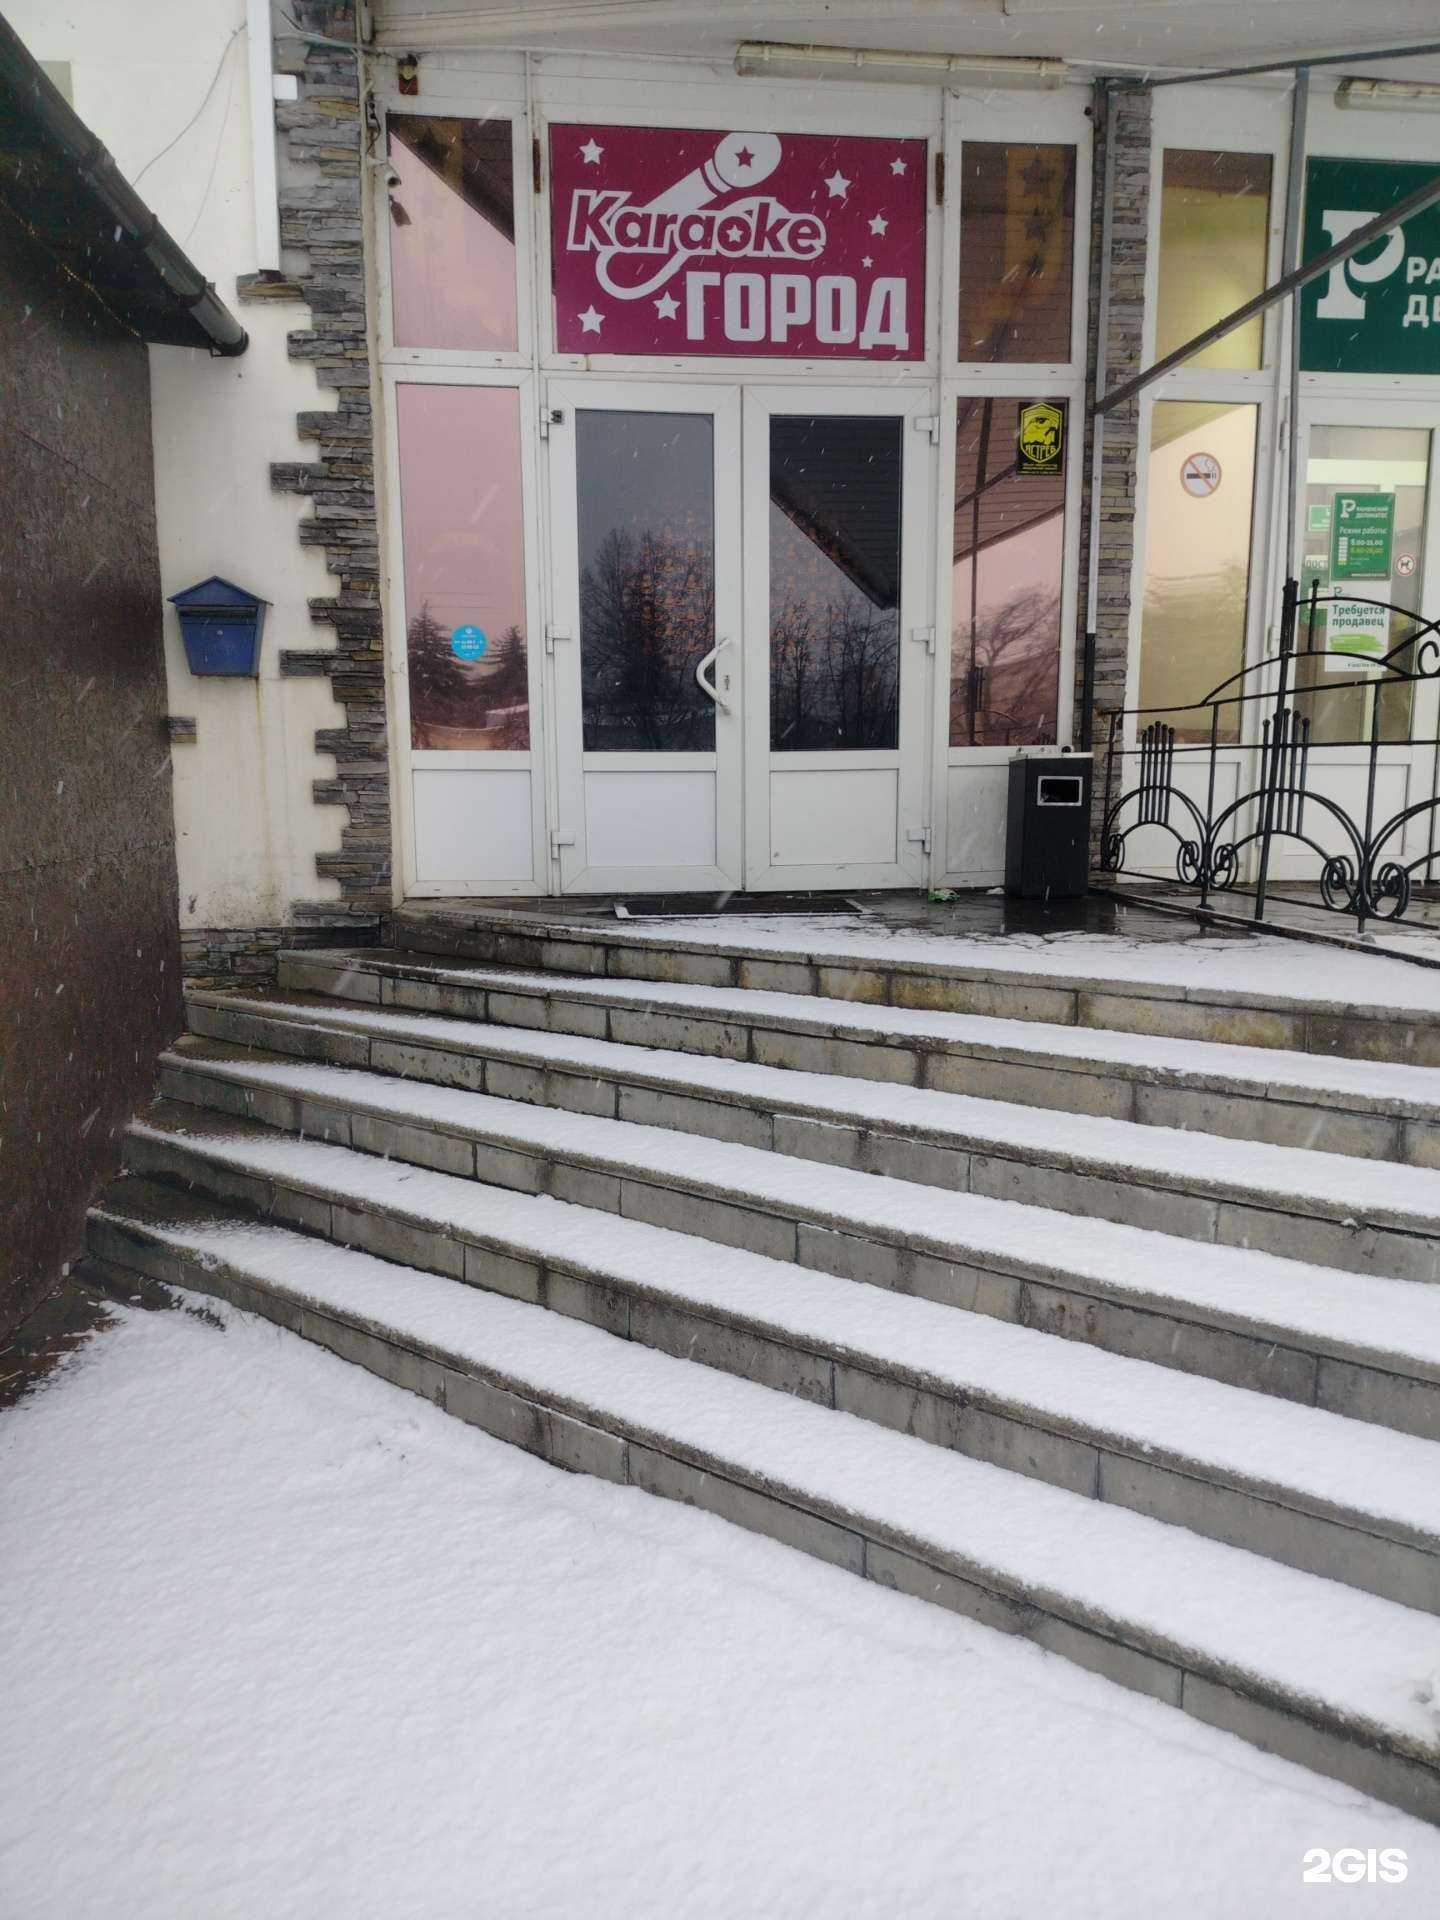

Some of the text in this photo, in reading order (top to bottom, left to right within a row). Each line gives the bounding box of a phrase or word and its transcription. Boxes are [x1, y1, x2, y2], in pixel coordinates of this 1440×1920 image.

[566, 189, 827, 261] Karaoke
[686, 271, 909, 350] ГОРОД
[1332, 604, 1386, 617] Требуется
[1332, 618, 1385, 628] продавец
